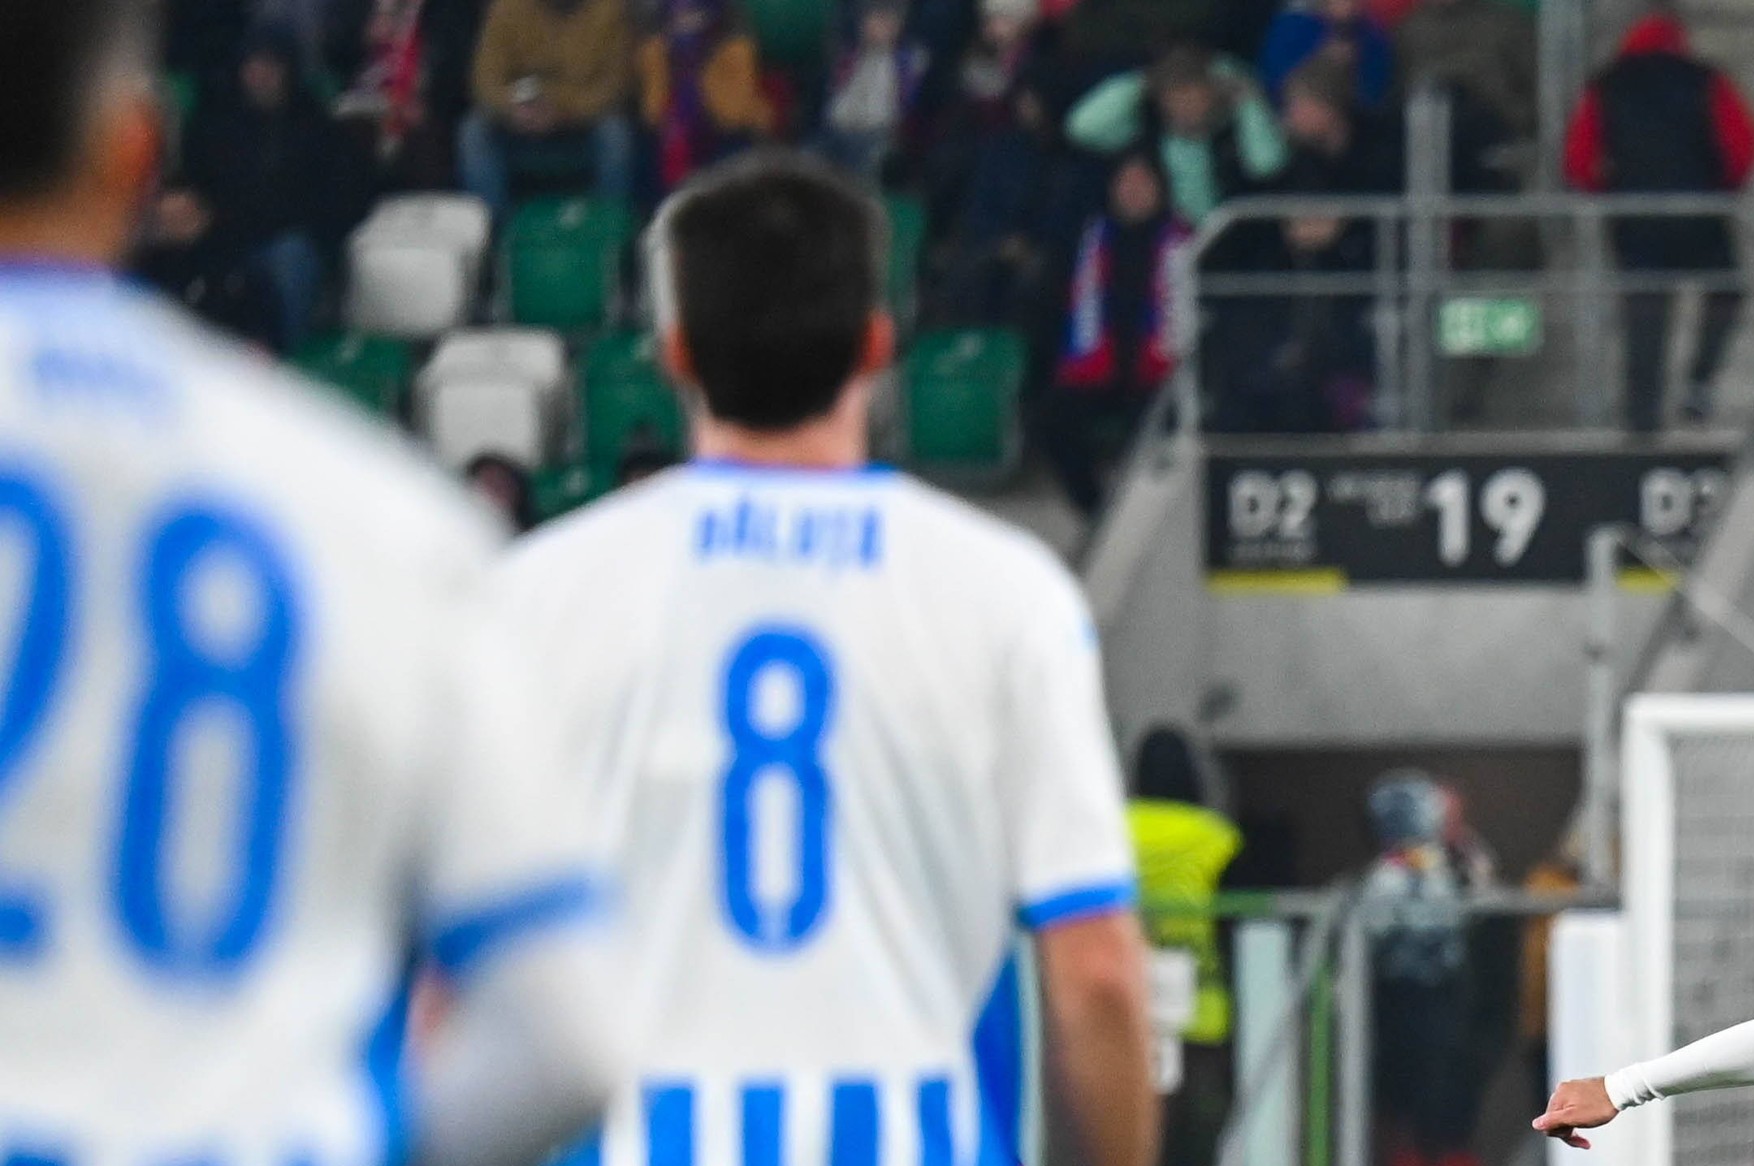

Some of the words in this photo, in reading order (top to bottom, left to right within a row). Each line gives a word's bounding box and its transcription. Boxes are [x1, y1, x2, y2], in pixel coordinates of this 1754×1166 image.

[1229, 468, 1318, 540] D2
[1425, 467, 1547, 567] 19
[718, 624, 835, 952] 8
